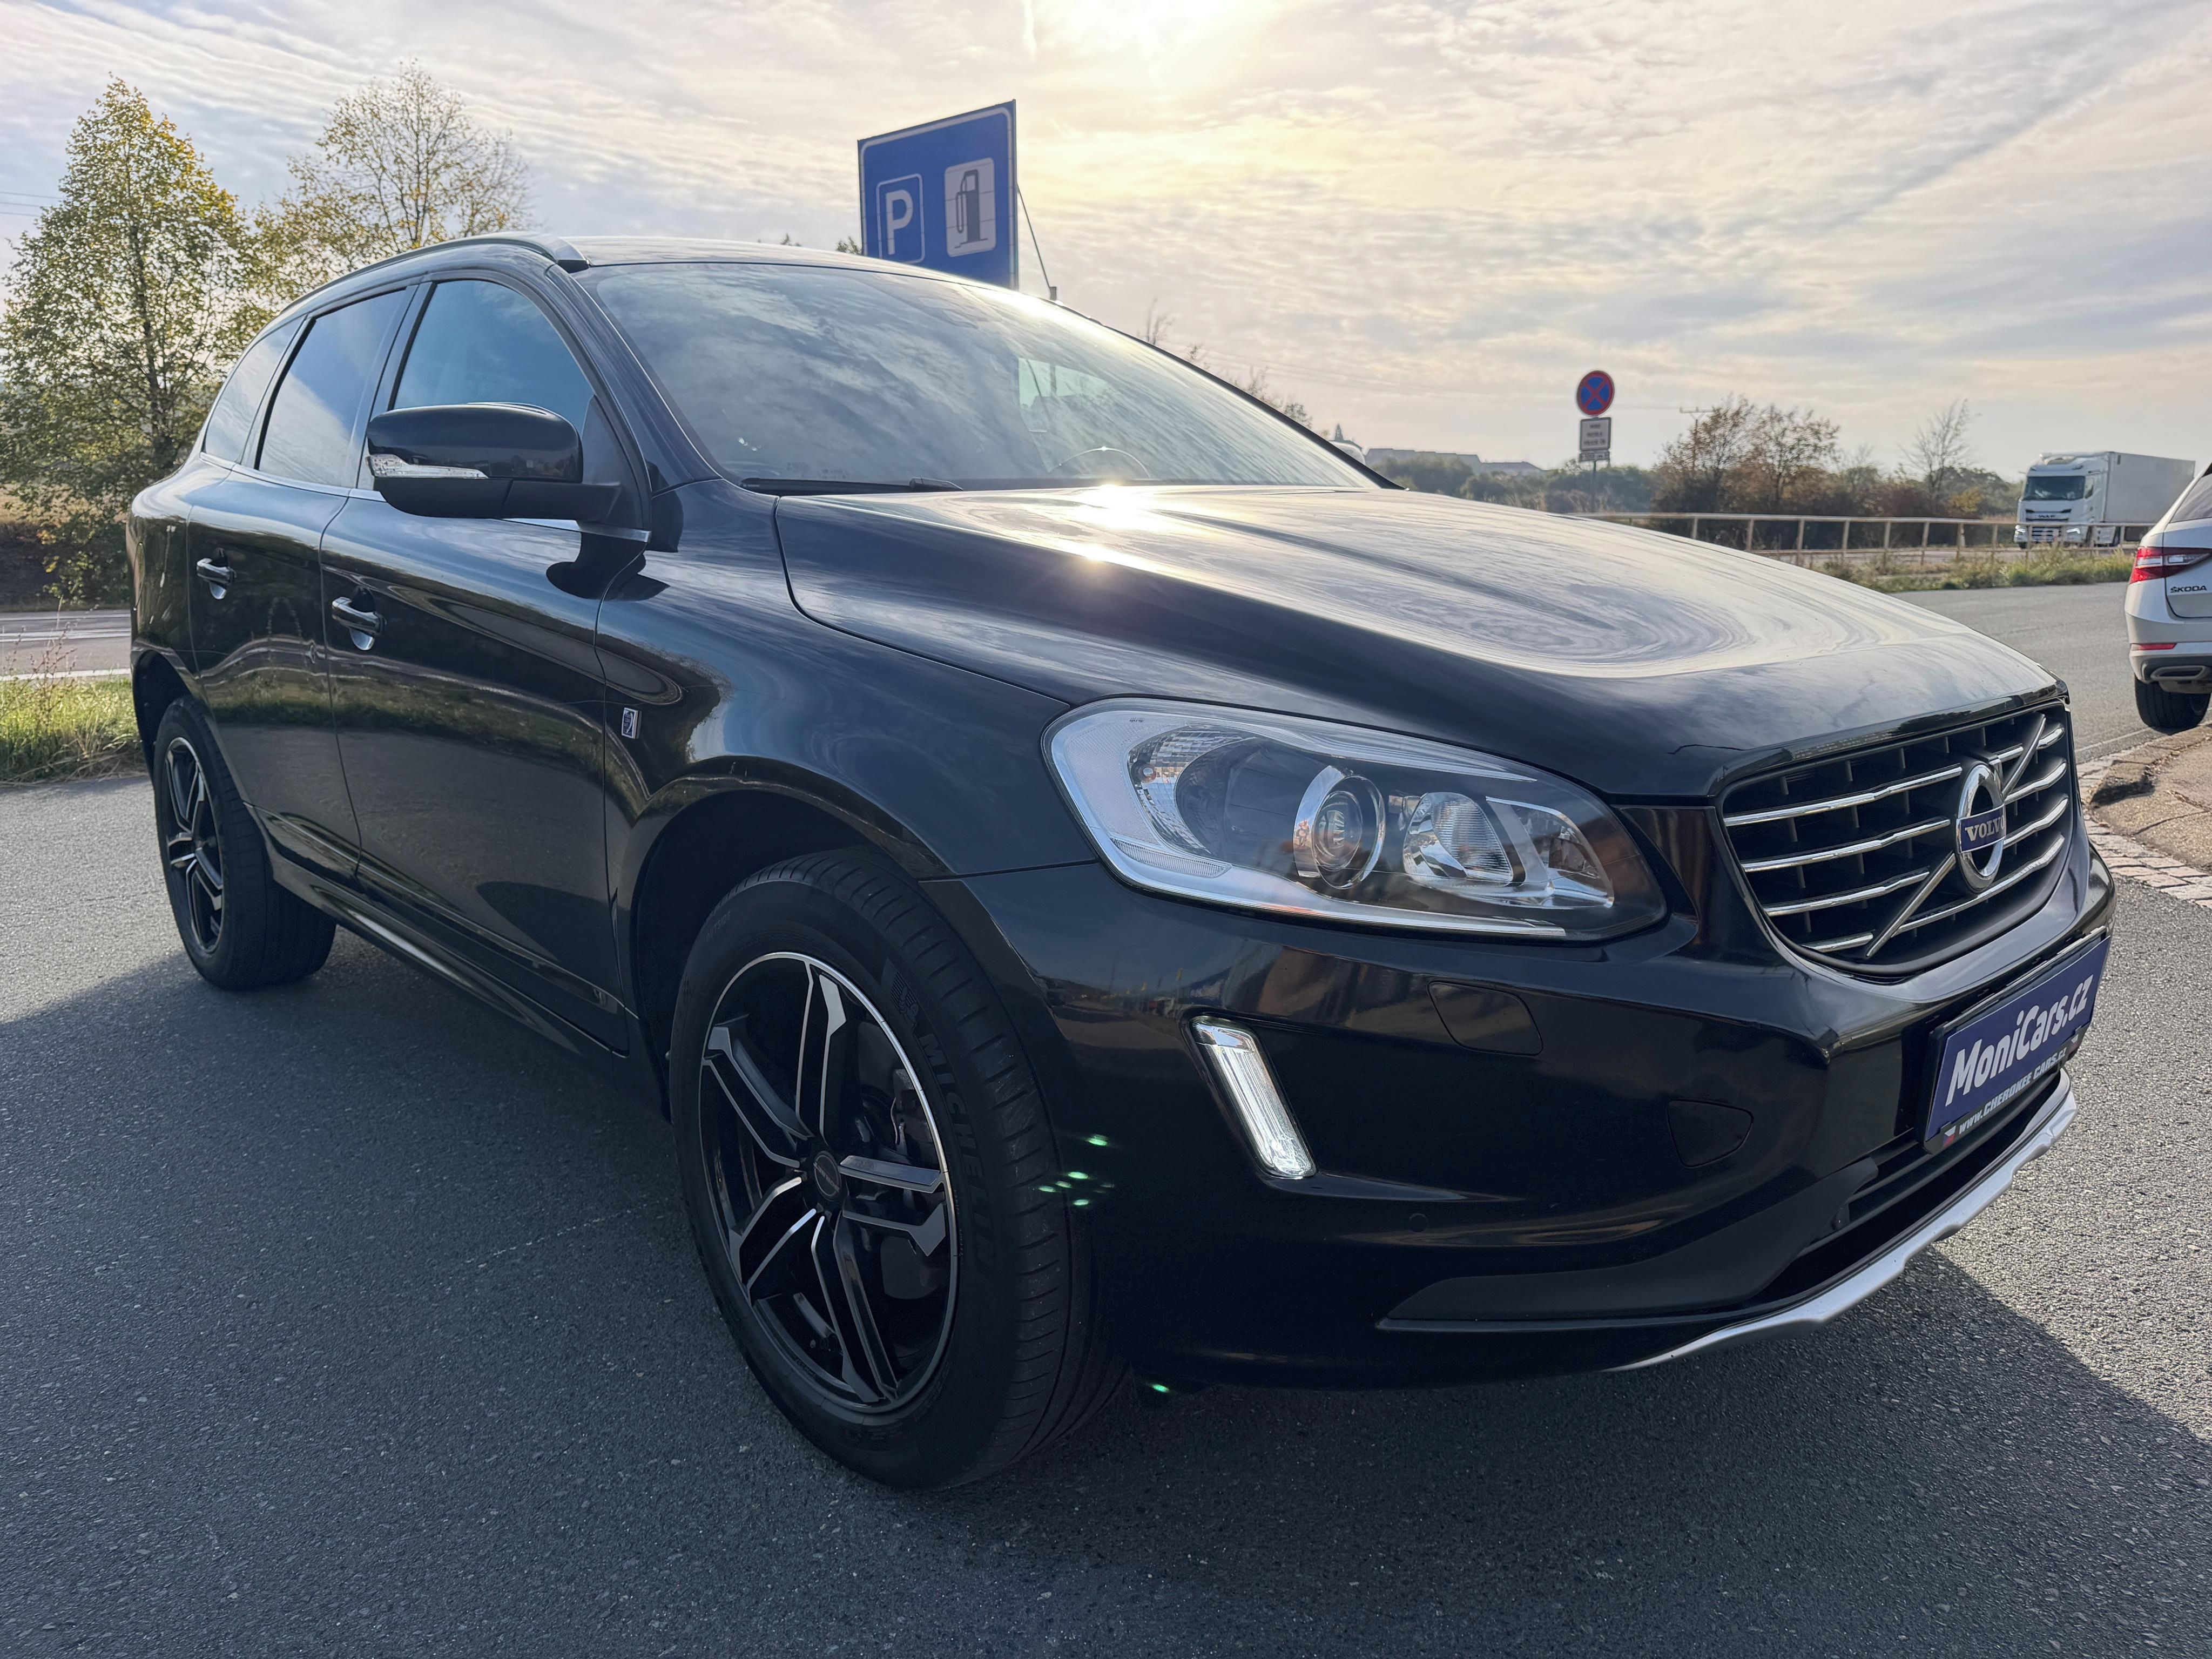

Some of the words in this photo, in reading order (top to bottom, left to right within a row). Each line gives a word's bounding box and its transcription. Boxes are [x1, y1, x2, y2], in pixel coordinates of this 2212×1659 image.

[886, 190, 913, 255] P
[1965, 815, 2005, 841] VOLVO
[1945, 974, 2093, 1107] MoniCars.cz
